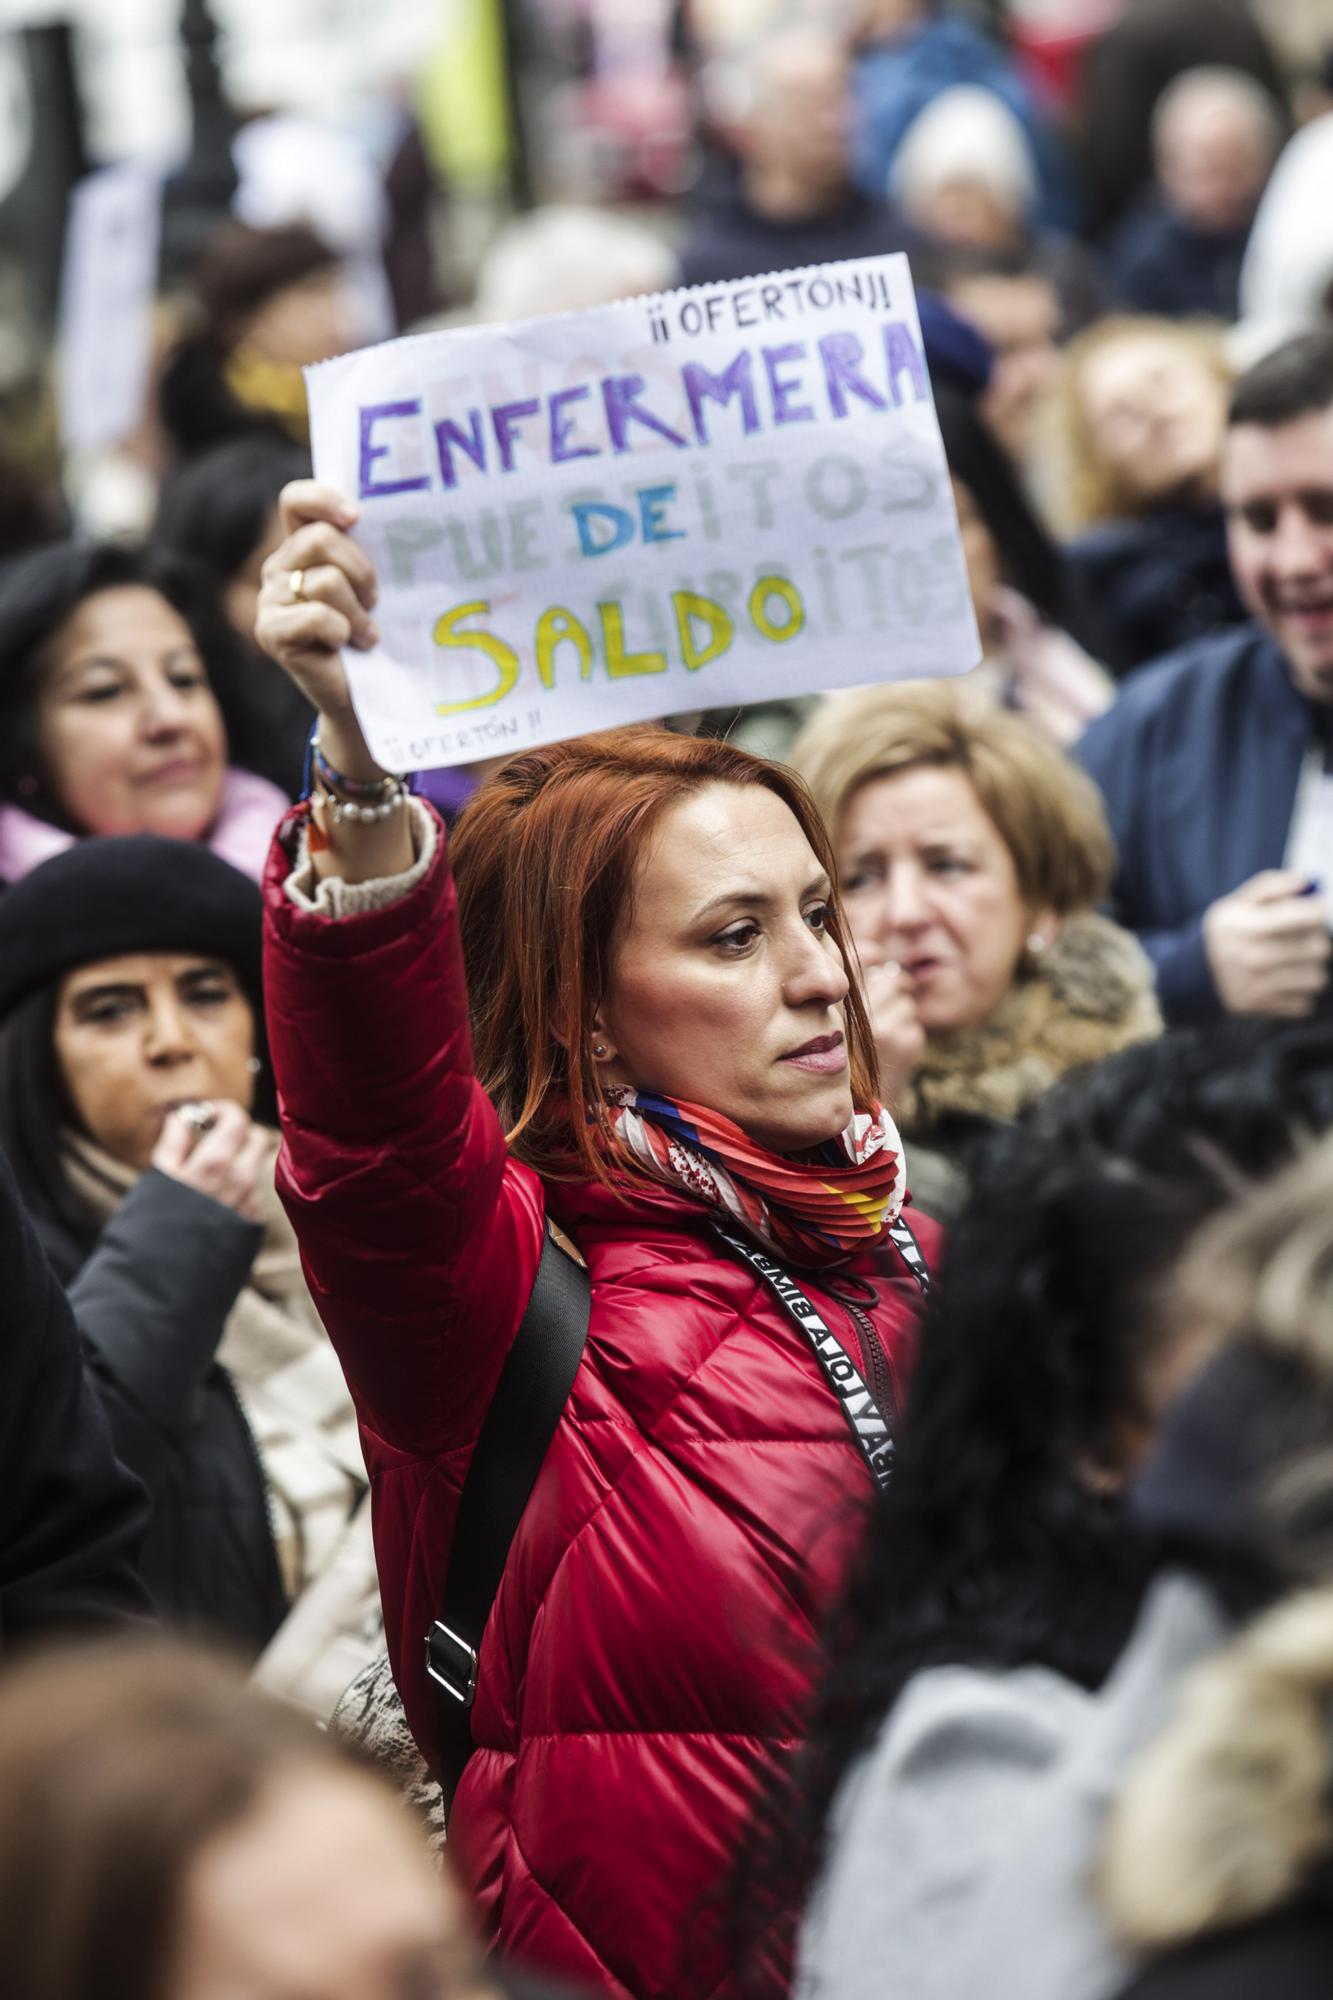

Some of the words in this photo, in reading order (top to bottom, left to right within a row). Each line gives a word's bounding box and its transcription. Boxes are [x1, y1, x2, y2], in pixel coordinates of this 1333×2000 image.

[357, 320, 929, 500] ENFERMERA
[572, 483, 687, 558] DE
[431, 575, 806, 717] SALDO
